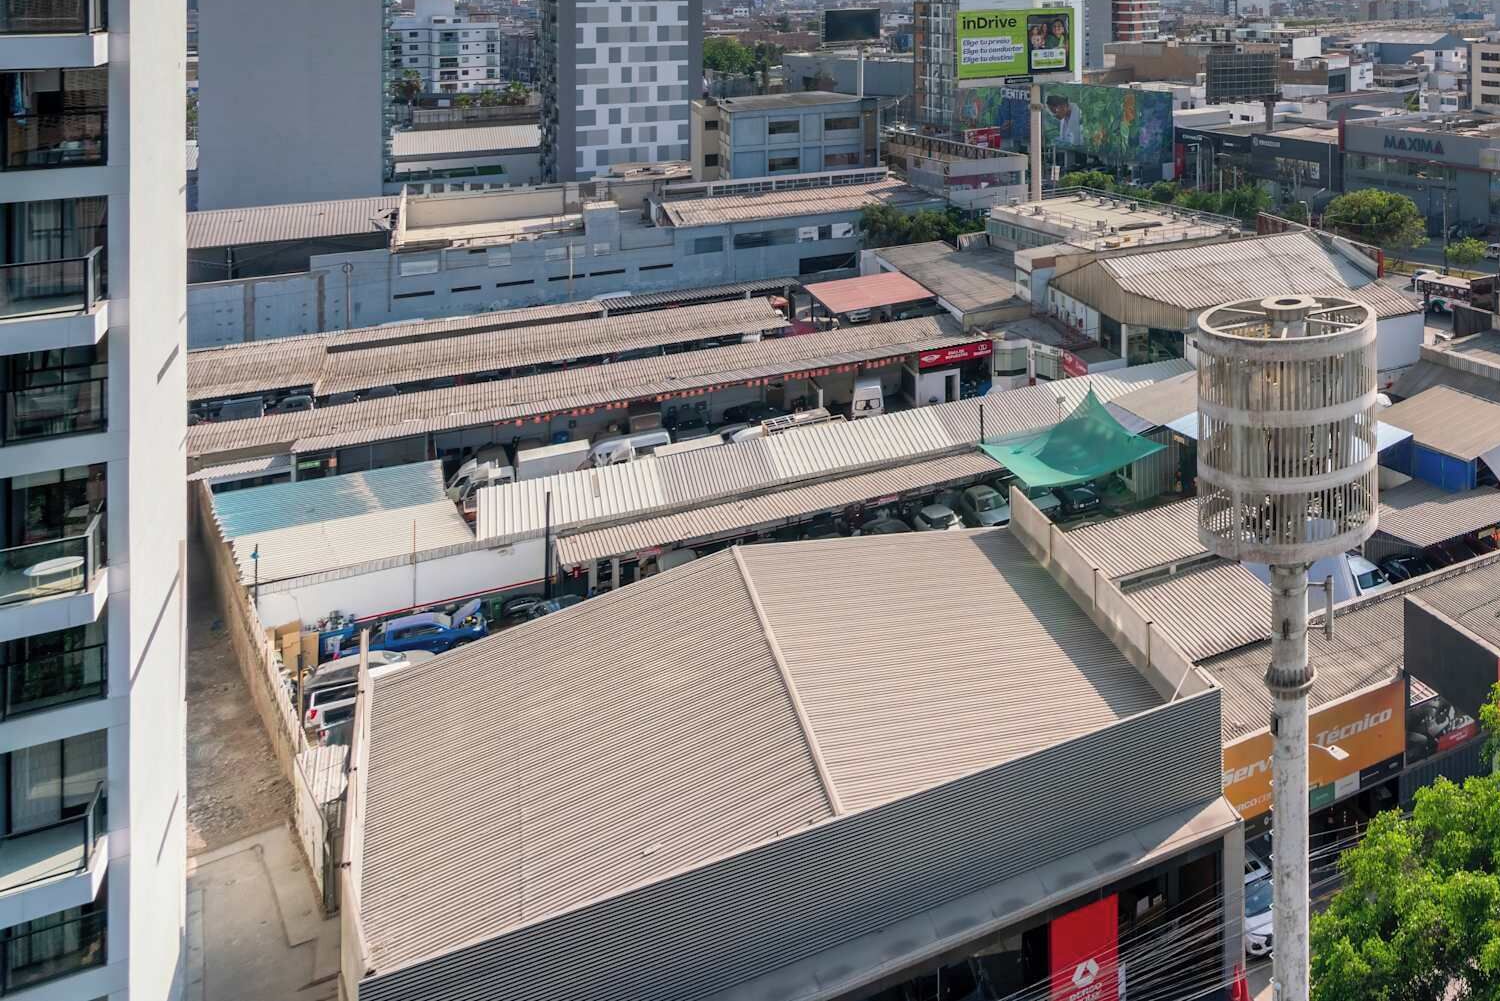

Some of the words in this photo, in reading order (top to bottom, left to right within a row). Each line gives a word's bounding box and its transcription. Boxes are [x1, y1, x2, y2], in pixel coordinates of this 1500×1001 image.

[962, 16, 1017, 30] inDrive
[1384, 135, 1445, 154] MAXIMA
[1315, 708, 1393, 746] Técnico
